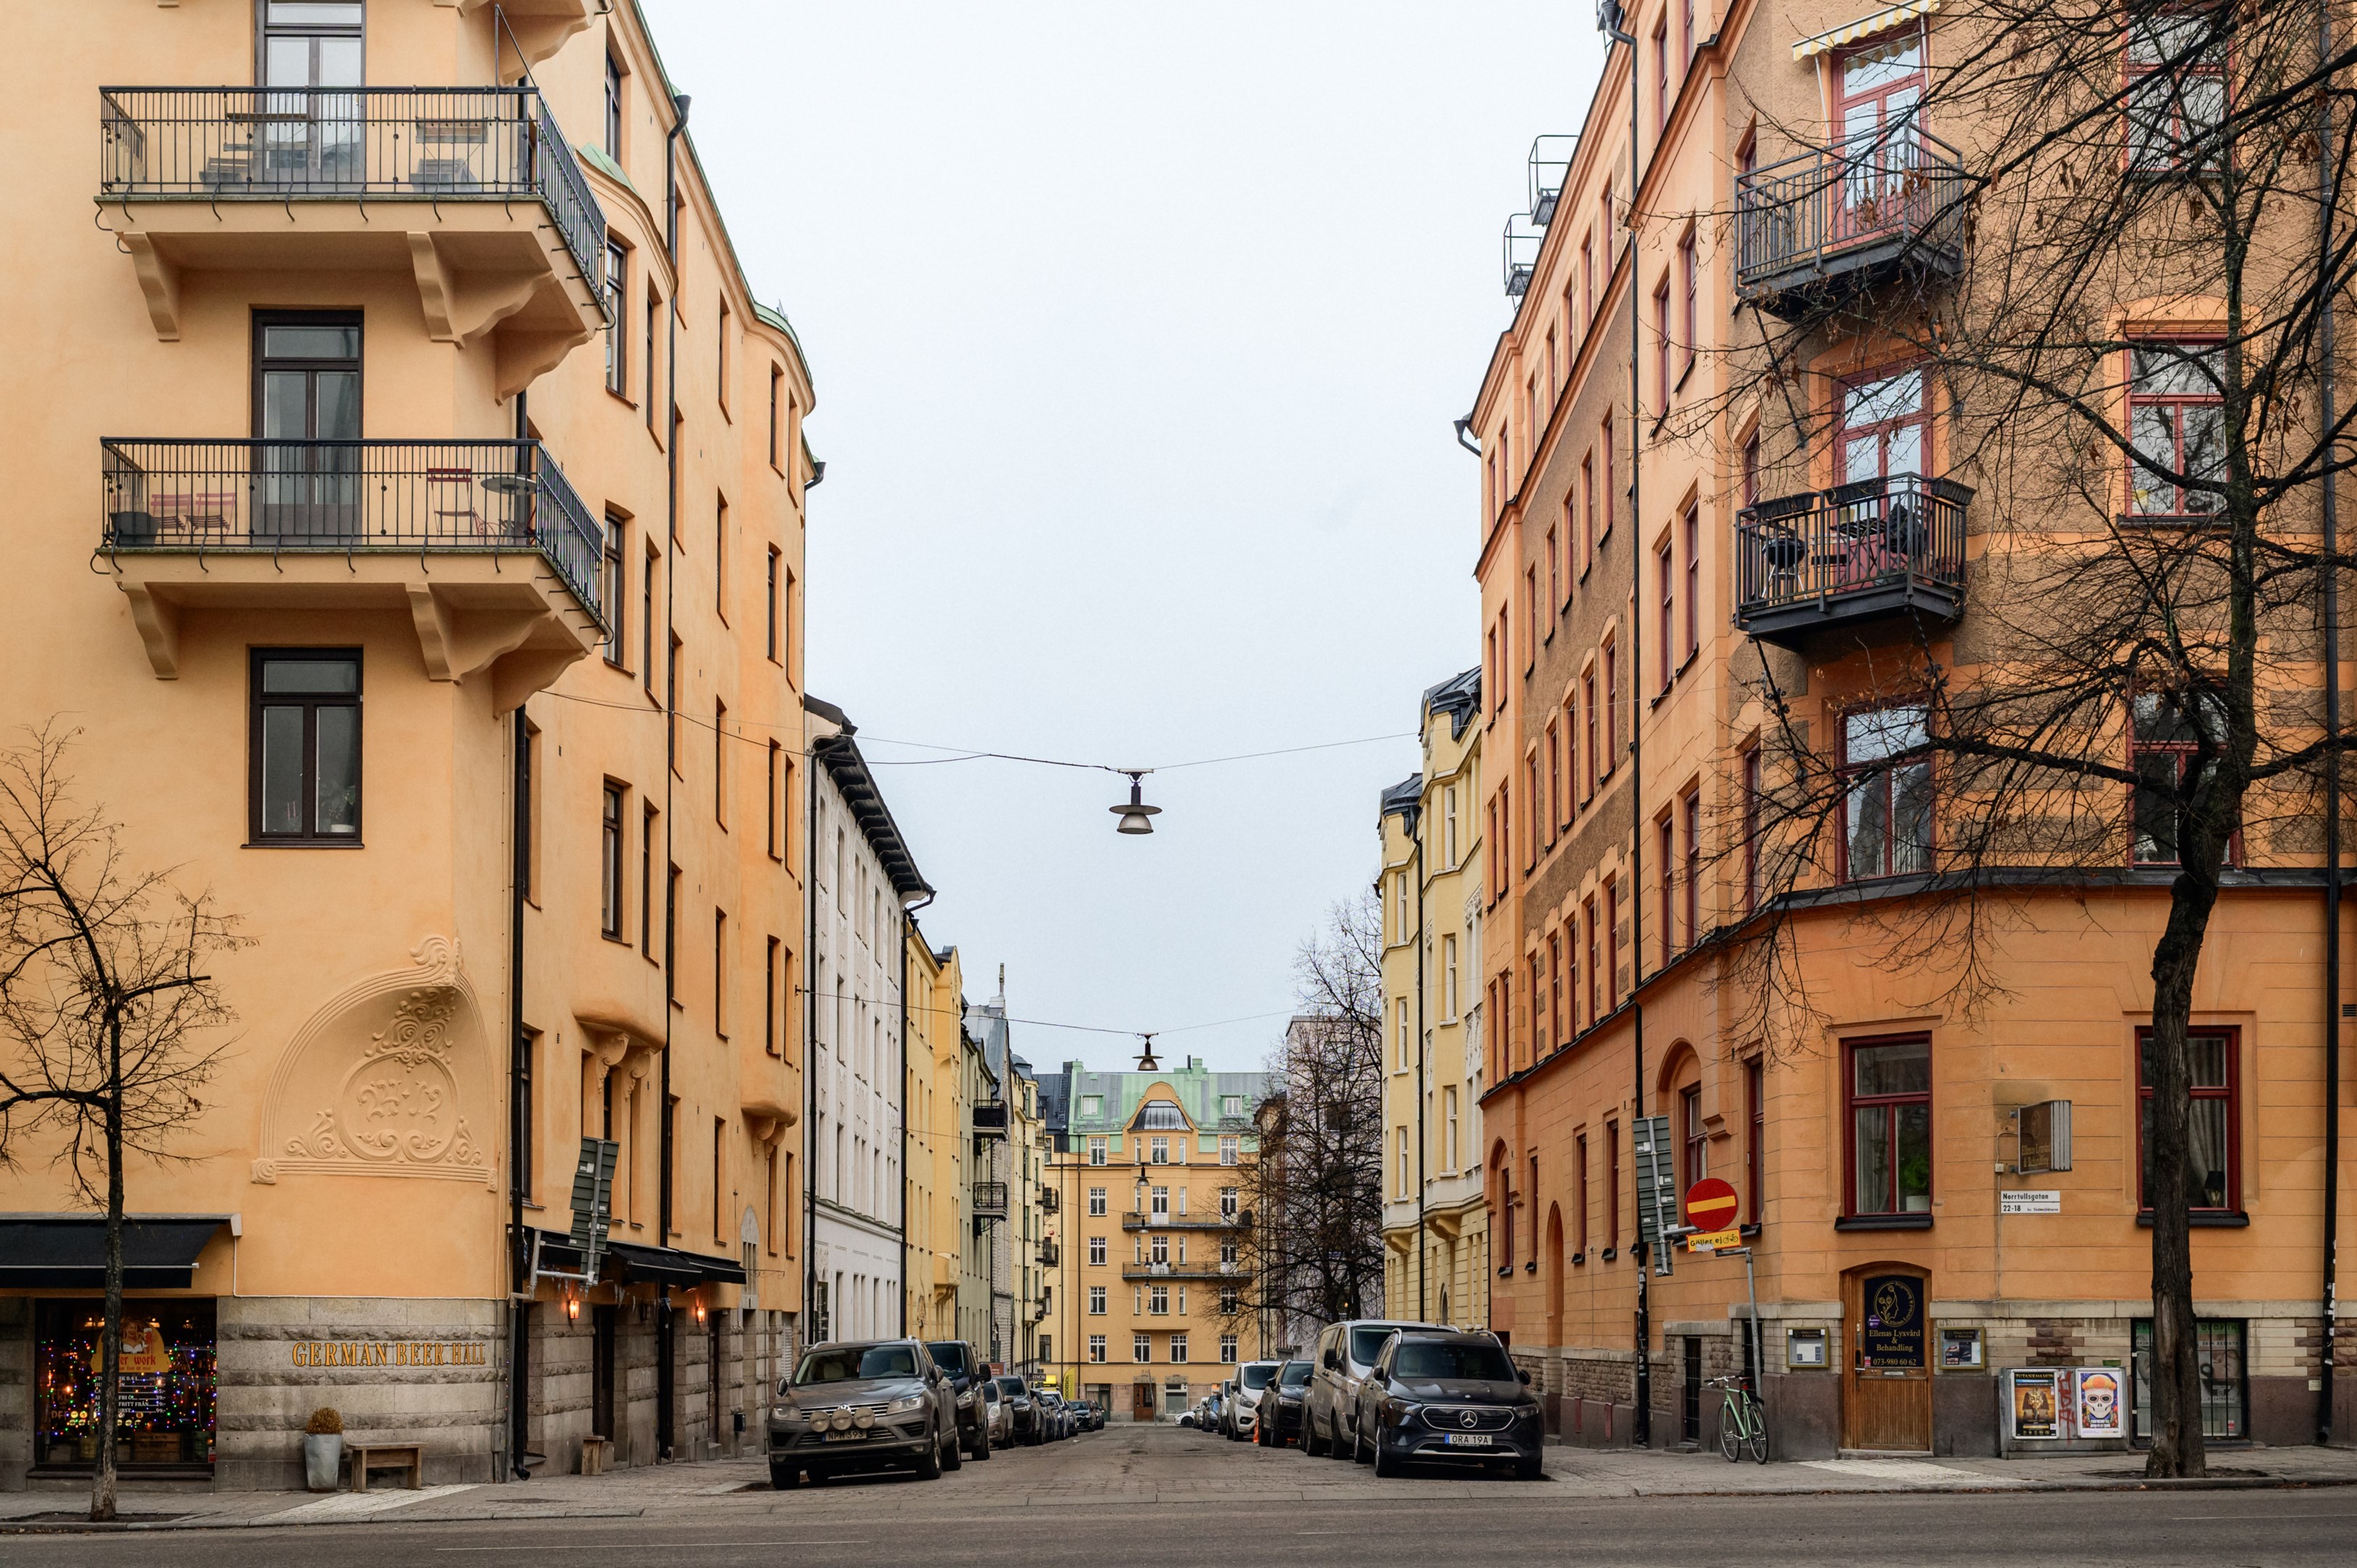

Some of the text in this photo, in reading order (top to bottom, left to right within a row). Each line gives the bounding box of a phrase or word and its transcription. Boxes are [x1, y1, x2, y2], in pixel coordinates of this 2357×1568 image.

[1894, 1329, 1921, 1338] Lyxvård
[1876, 1344, 1913, 1352] Behandling
[292, 1342, 486, 1367] GERMAN BEER HALL
[134, 1355, 156, 1365] work
